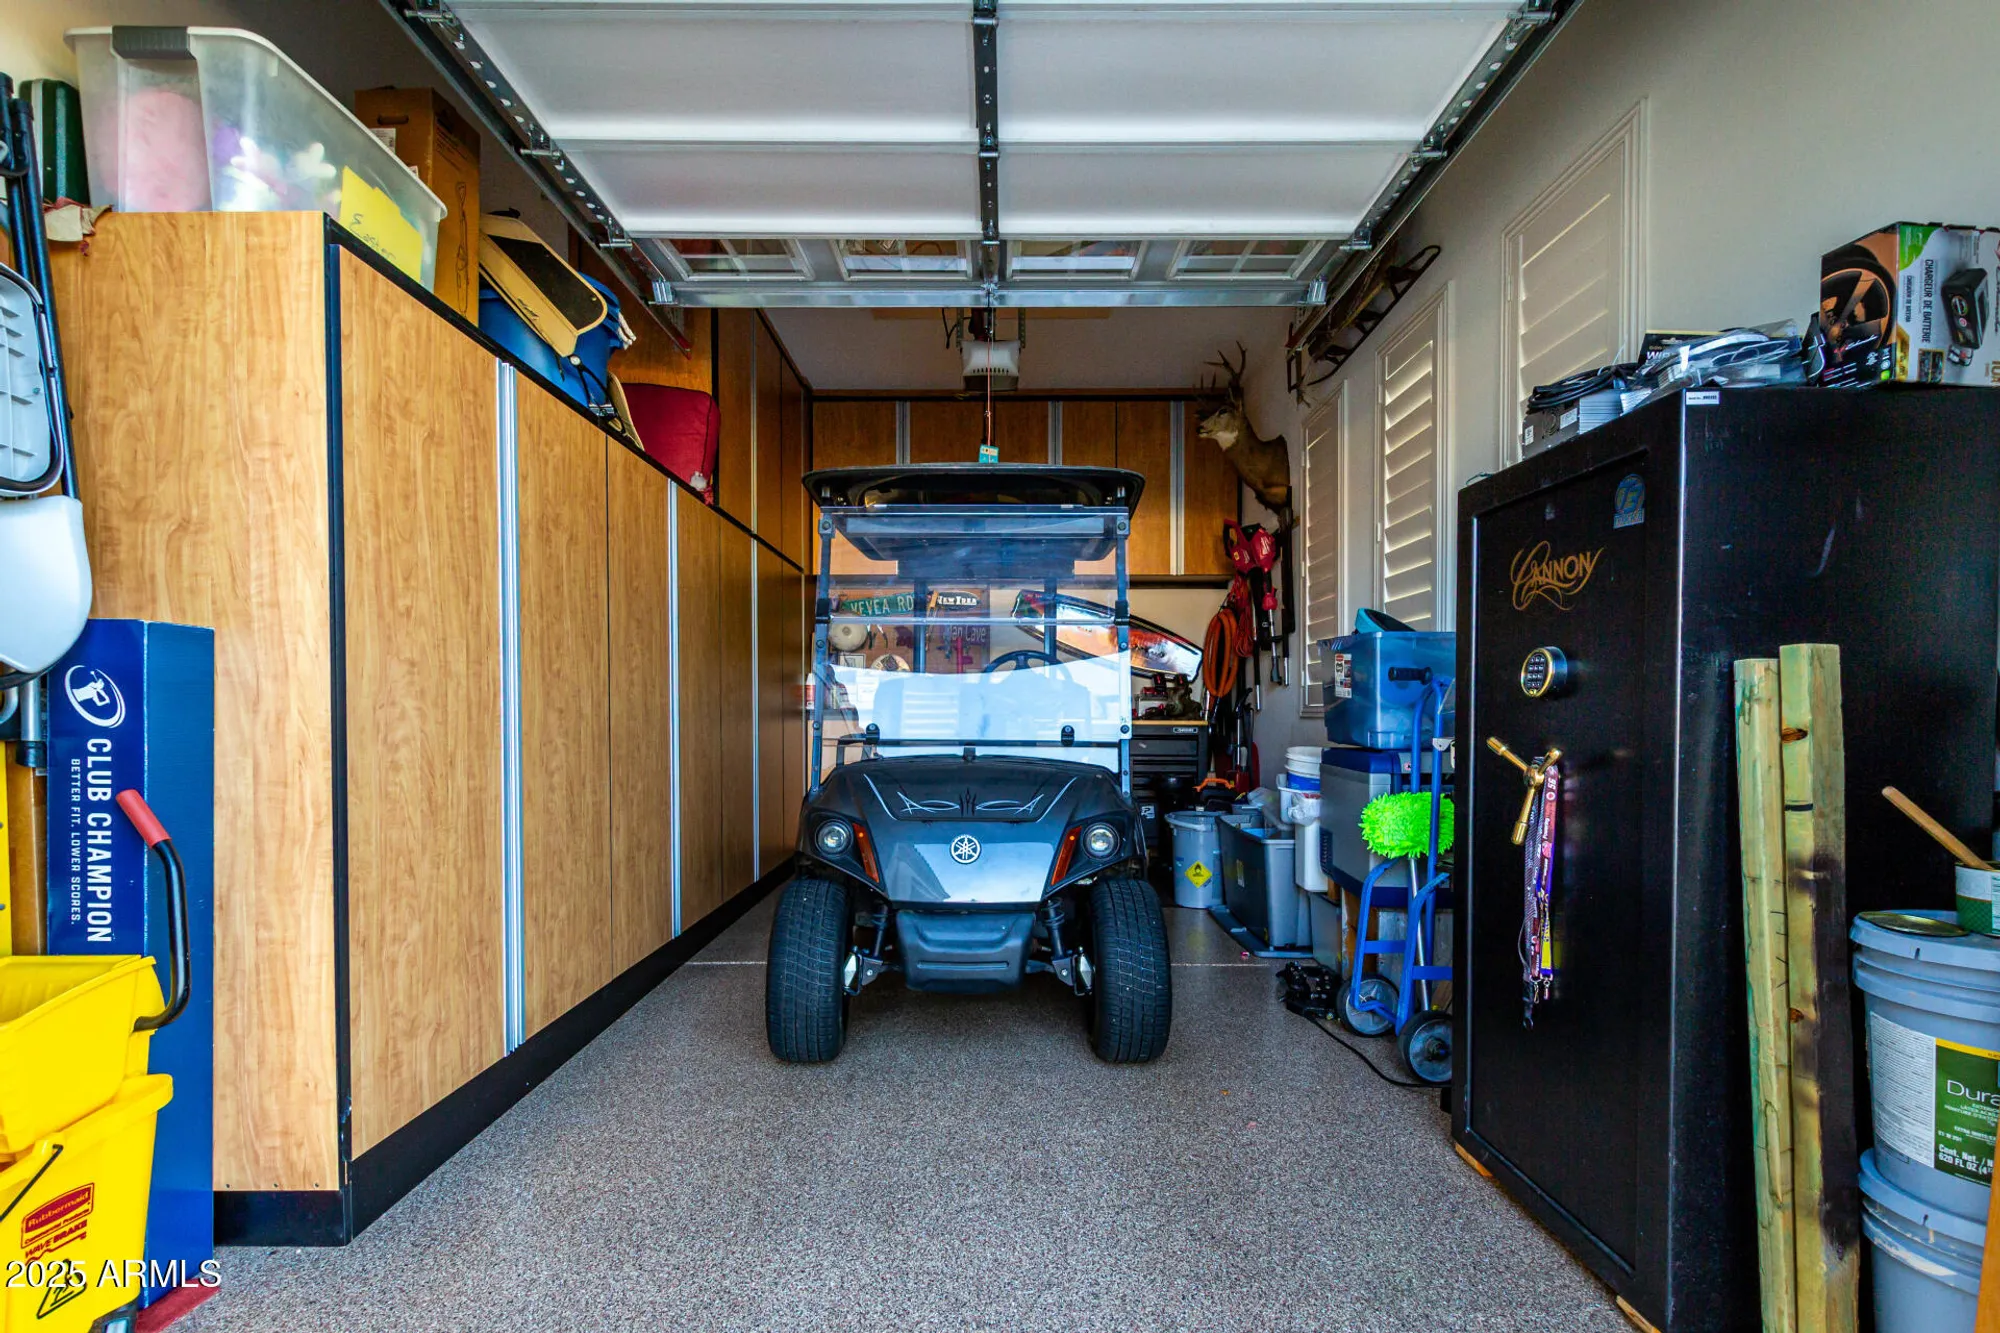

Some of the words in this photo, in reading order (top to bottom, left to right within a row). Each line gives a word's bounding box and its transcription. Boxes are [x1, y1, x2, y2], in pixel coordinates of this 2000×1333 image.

[1925, 259, 1934, 298] CHARGEUR
[1923, 300, 1933, 310] DE
[1922, 311, 1932, 344] BATTERIE
[897, 595, 914, 611] RD
[965, 625, 986, 643] Cave
[71, 758, 81, 802] BETTER
[87, 738, 112, 801] CLUB
[71, 806, 81, 828] FIT.
[71, 832, 81, 873] LOWER
[87, 813, 112, 942] CHAMPION
[71, 876, 81, 925] SCORES.
[1955, 1157, 1965, 1168] FL
[28, 1191, 89, 1228] Rubbermaid
[25, 1238, 53, 1258] WAVE
[53, 1219, 87, 1243] BRAKE
